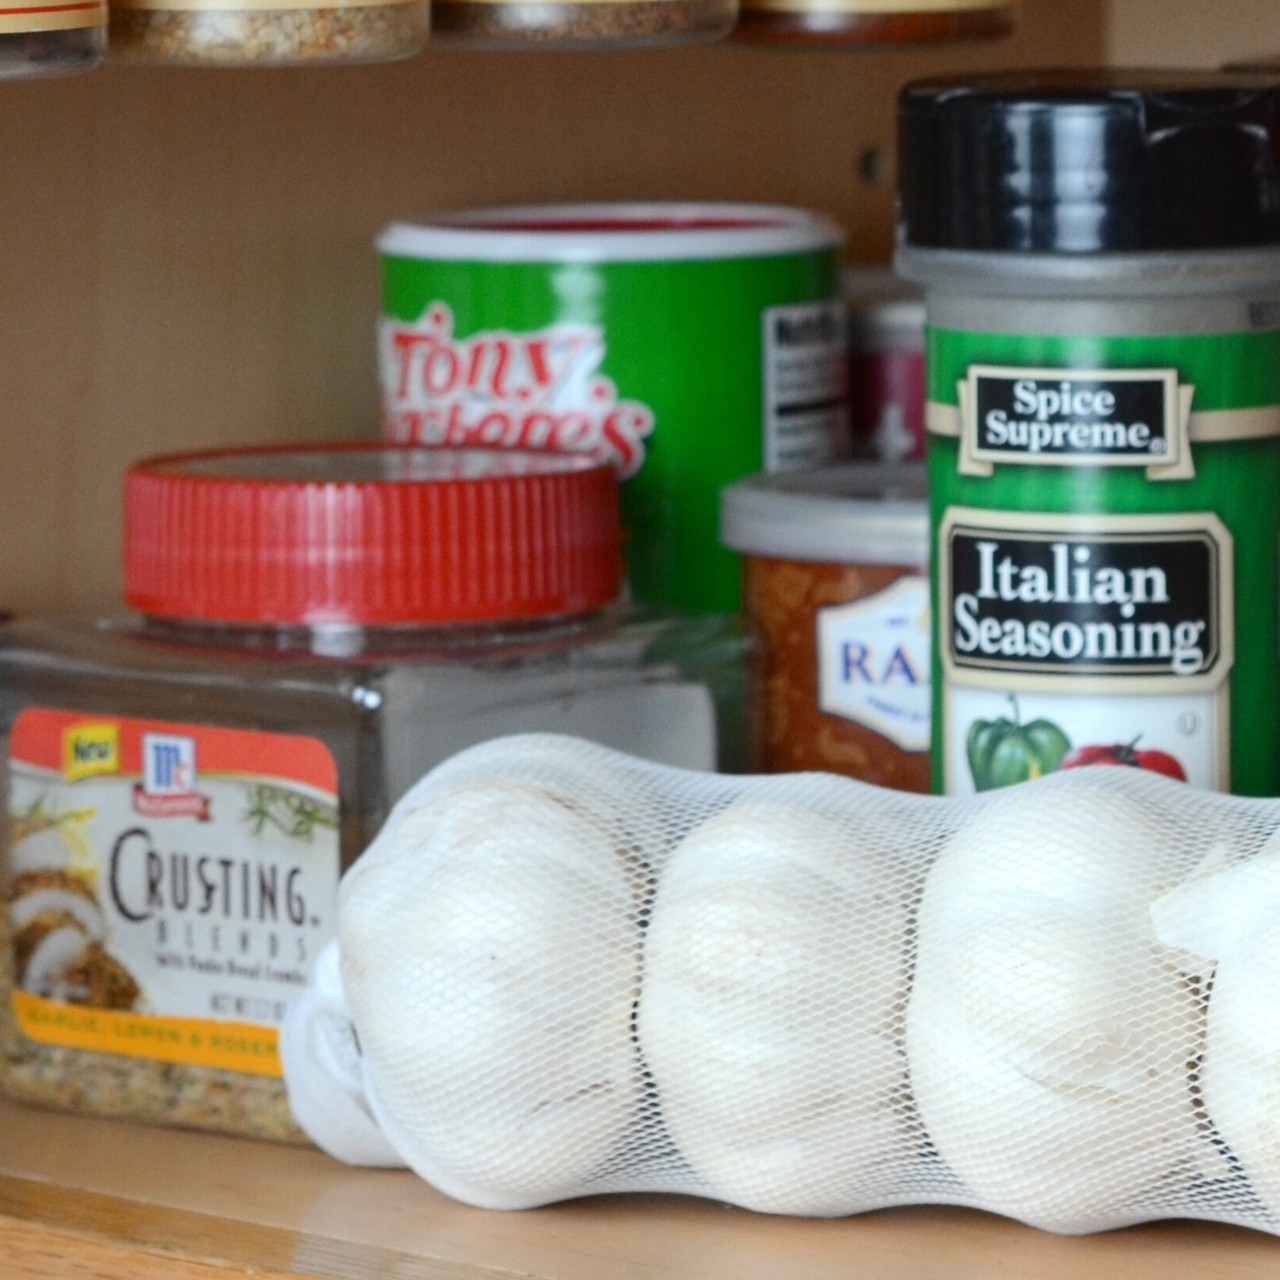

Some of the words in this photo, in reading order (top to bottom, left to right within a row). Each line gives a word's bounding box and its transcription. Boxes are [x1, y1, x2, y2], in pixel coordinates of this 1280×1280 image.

[1013, 380, 1115, 420] Spice
[976, 542, 1171, 605] Italian
[954, 592, 1206, 676] Seasoning
